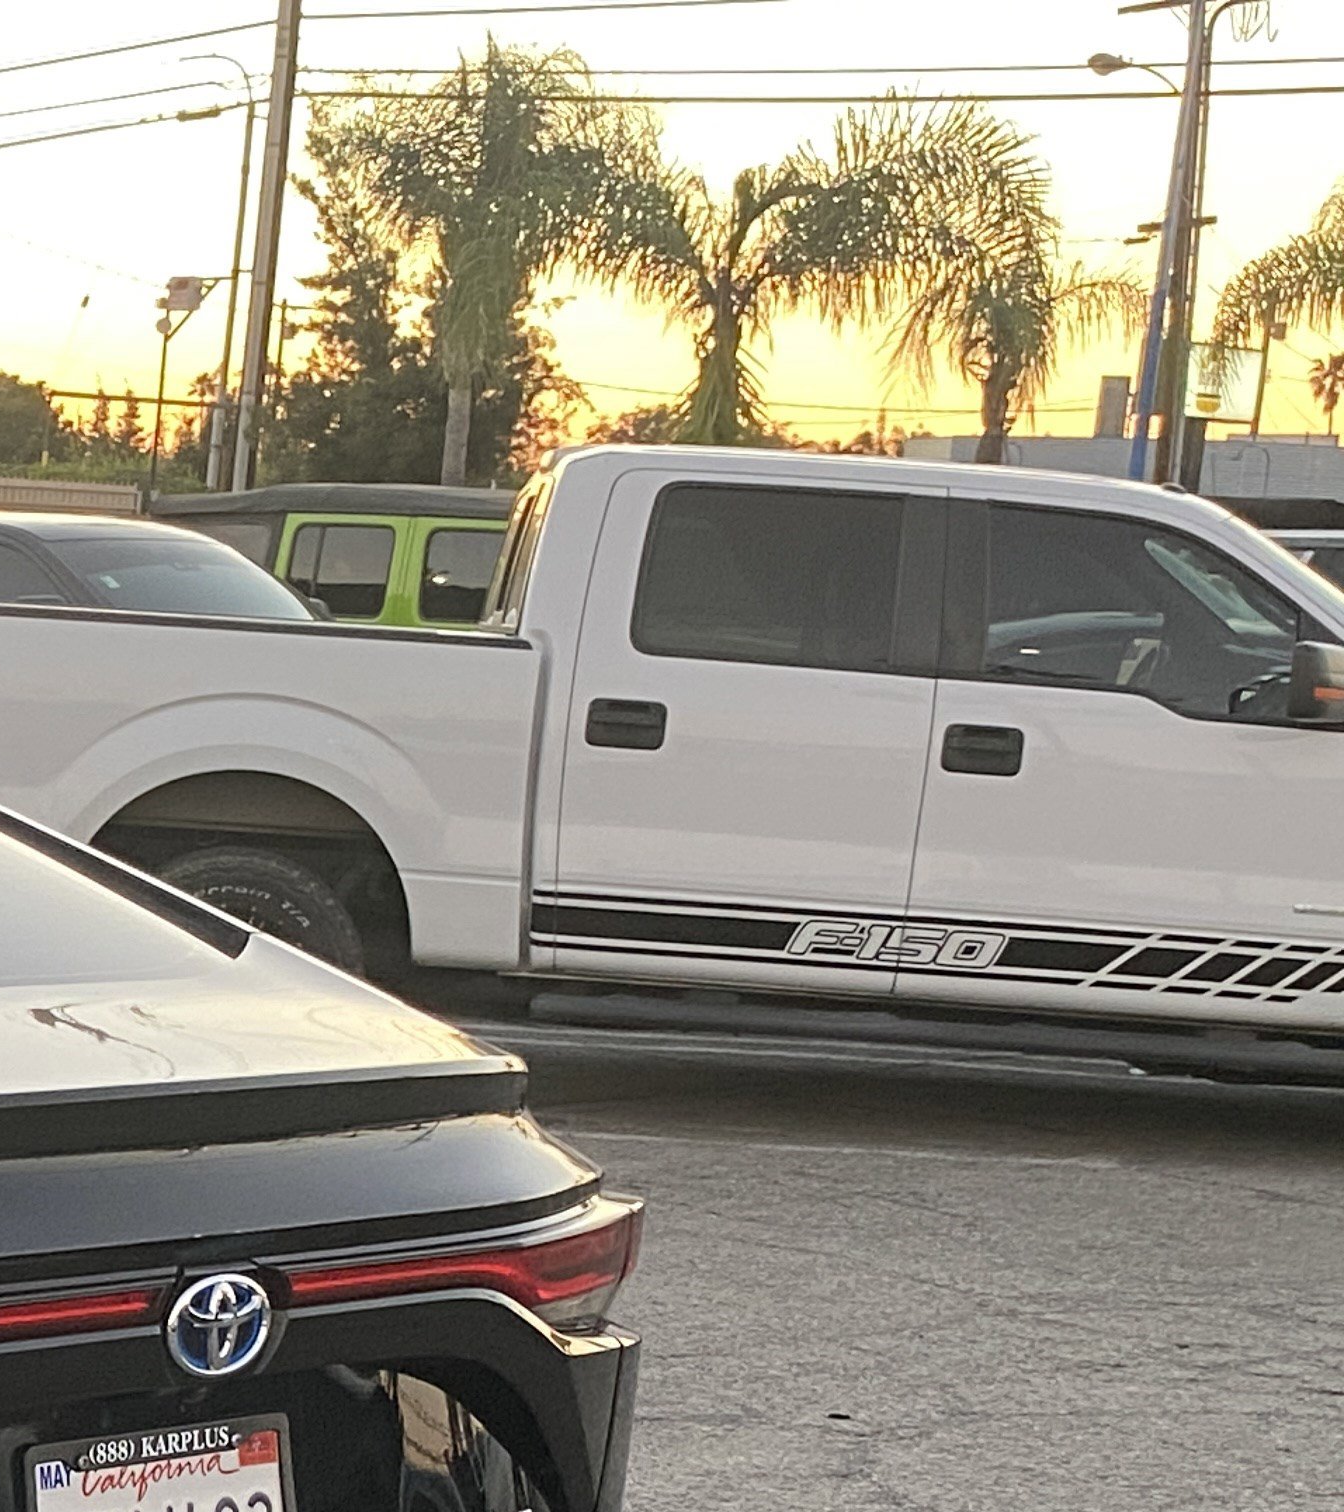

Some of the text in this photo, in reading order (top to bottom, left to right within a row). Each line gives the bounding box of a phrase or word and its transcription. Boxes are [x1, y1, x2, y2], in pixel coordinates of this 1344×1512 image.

[787, 920, 1010, 969] F-150
[88, 1439, 135, 1464] (888)
[141, 1427, 230, 1458] KARPLUS
[39, 1464, 71, 1490] MAY
[81, 1453, 240, 1501] California
